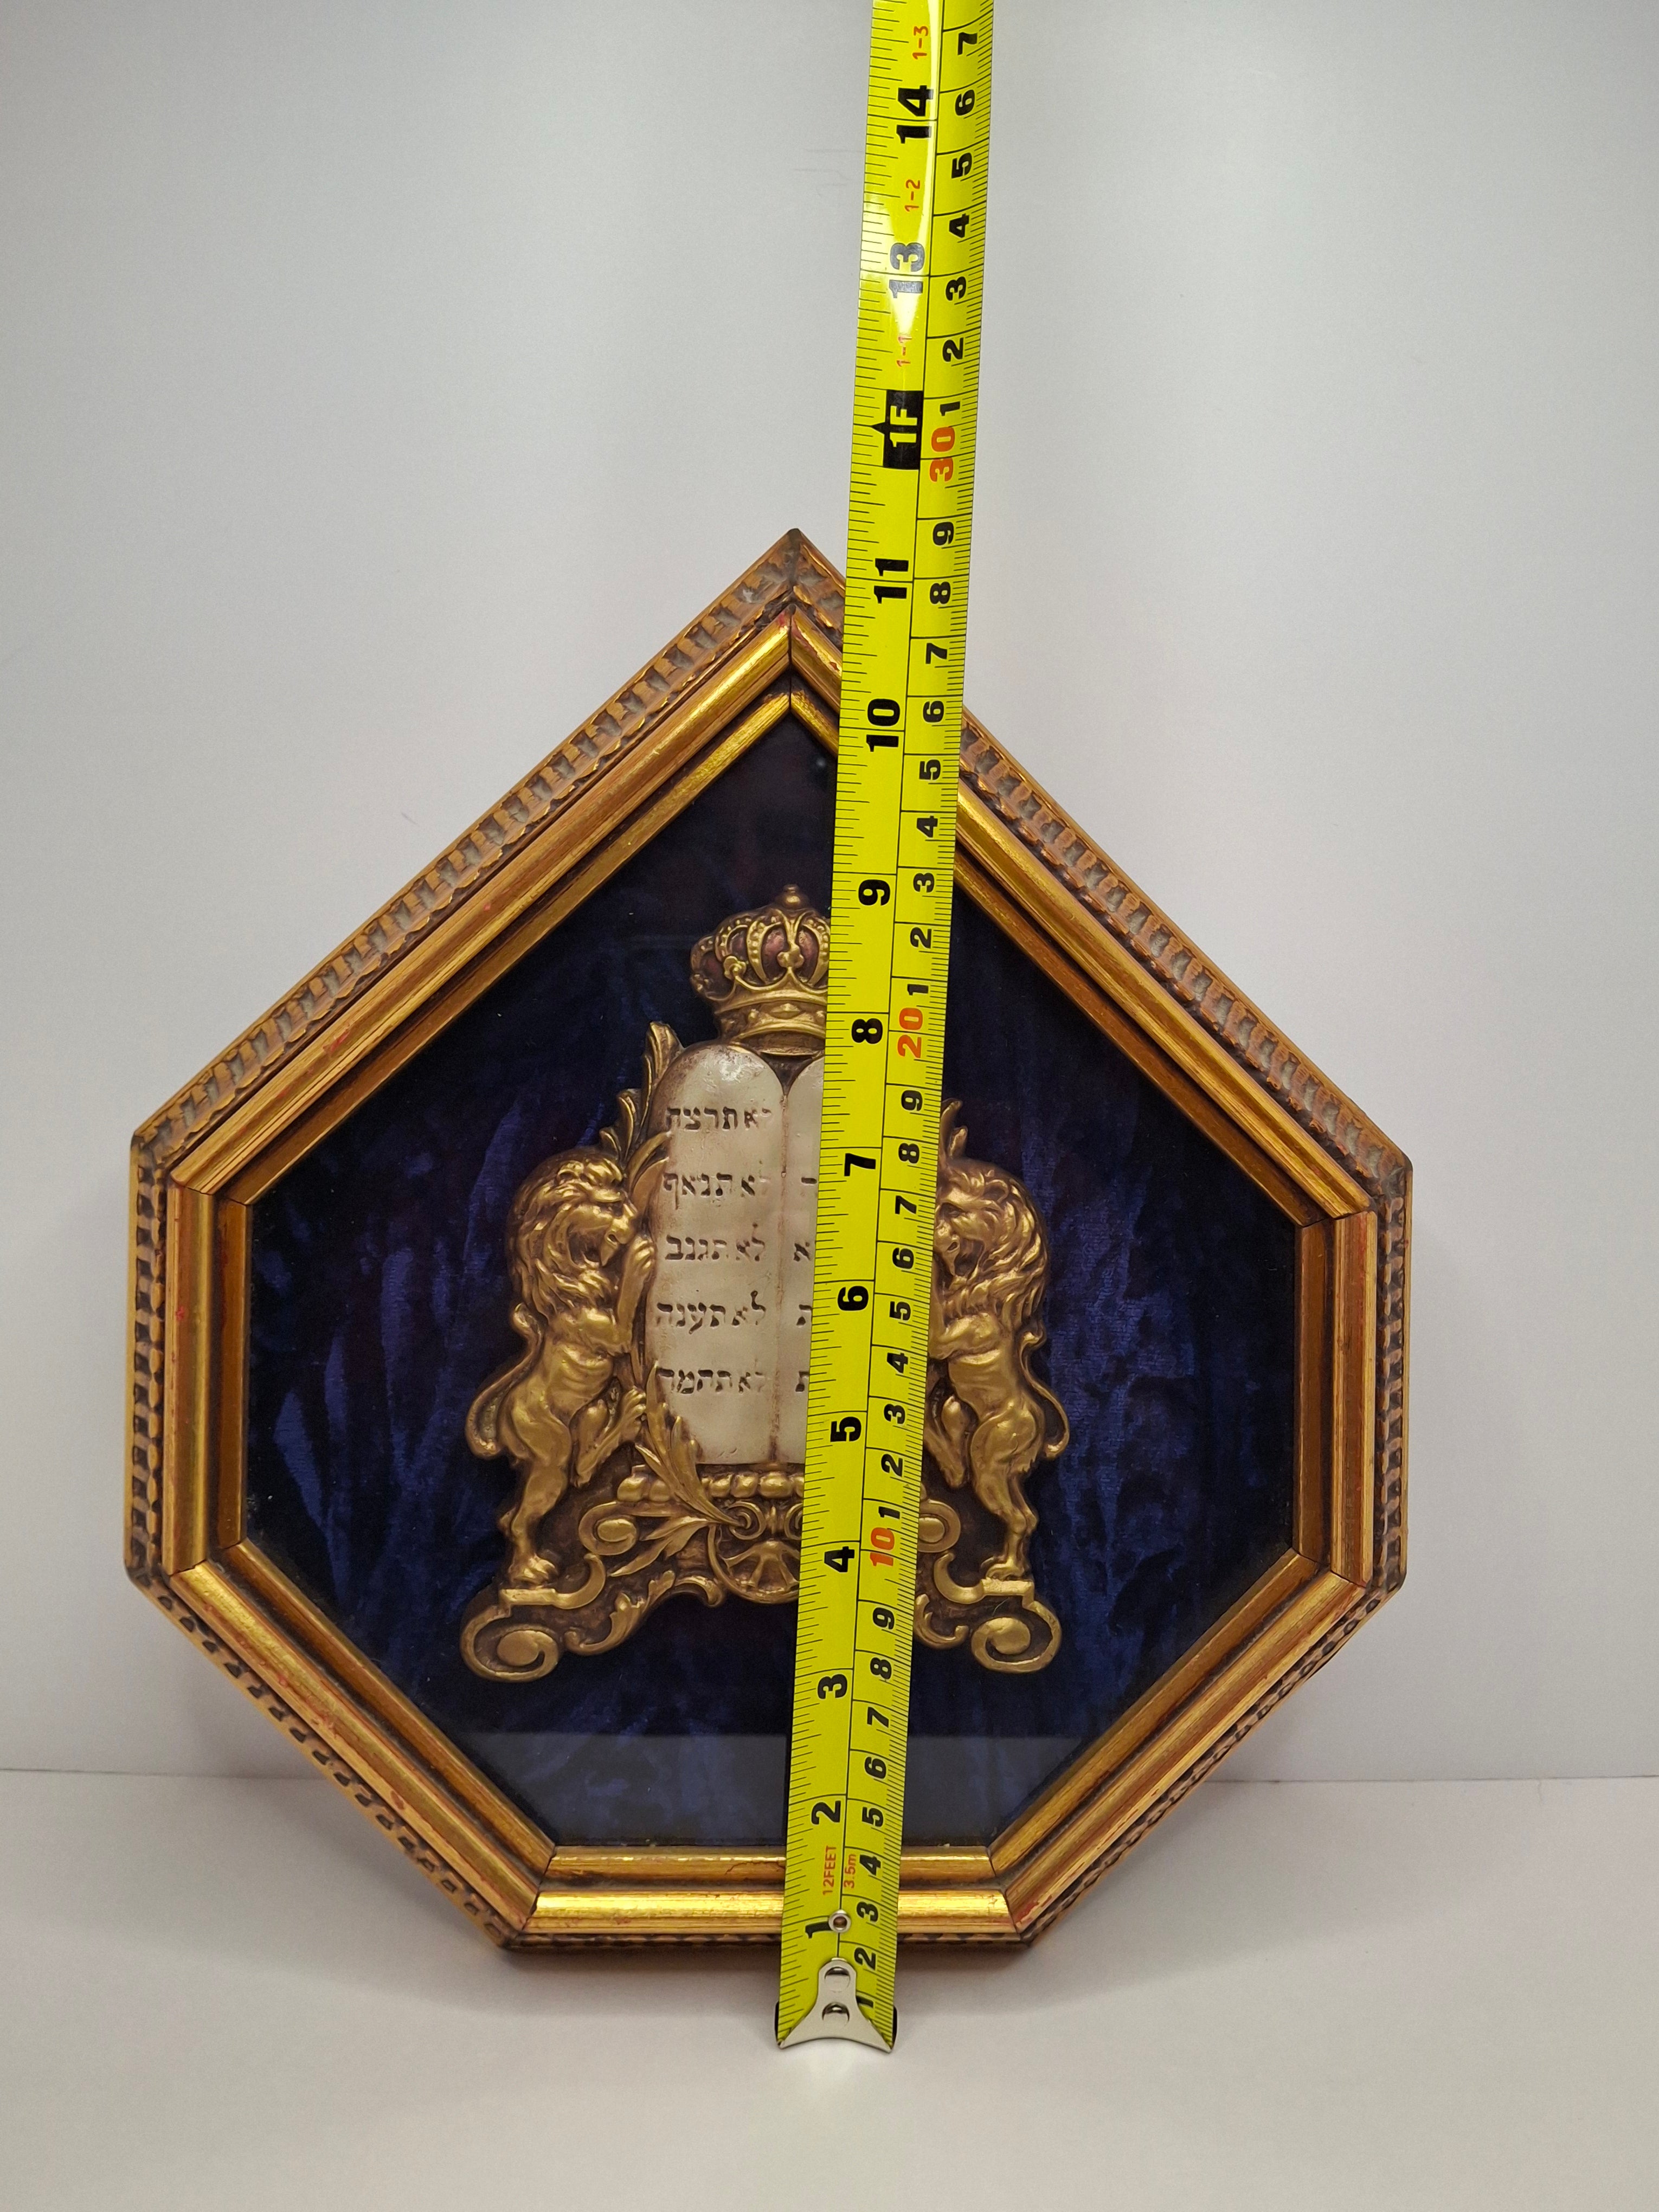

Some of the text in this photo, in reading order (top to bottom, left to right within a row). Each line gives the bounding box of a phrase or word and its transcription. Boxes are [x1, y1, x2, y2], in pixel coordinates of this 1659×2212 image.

[912, 26, 928, 60] 1-3
[957, 32, 978, 55] 7
[955, 89, 975, 116] 6
[896, 85, 933, 144] 14
[951, 152, 973, 178] 5
[904, 179, 920, 212] 1-2
[949, 214, 969, 237] 4
[889, 242, 925, 299] 13
[946, 276, 966, 301] 3
[942, 337, 964, 362] 2
[940, 401, 961, 416] 1
[890, 406, 918, 447] 1F
[930, 427, 955, 481] 30
[933, 521, 954, 545] 9
[873, 558, 909, 604] 11
[930, 581, 951, 605] 8
[925, 642, 948, 664] 7
[923, 700, 944, 723] 6
[866, 698, 901, 753] 10
[918, 759, 941, 780] 5
[917, 816, 938, 837] 4
[858, 879, 890, 906] 9
[913, 872, 934, 892] 3
[909, 927, 931, 948] 2
[906, 984, 929, 996] 1
[851, 1018, 882, 1044] 8
[897, 1007, 923, 1058] 20
[901, 1090, 923, 1111] 9
[844, 1153, 876, 1176] 7
[898, 1142, 920, 1164] 8
[895, 1195, 917, 1214] 7
[892, 1248, 914, 1269] 6
[837, 1285, 869, 1311] 6
[889, 1301, 911, 1321] 5
[886, 1353, 909, 1373] 4
[884, 1403, 906, 1425] 3
[830, 1416, 861, 1442] 5
[881, 1454, 903, 1477] 2
[878, 1505, 901, 1520] 1
[870, 1527, 895, 1567] 10
[824, 1546, 855, 1573] 4
[872, 1607, 895, 1630] 9
[870, 1656, 892, 1680] 8
[818, 1673, 848, 1699] 3
[867, 1707, 890, 1729] 7
[865, 1756, 888, 1780] 6
[811, 1801, 841, 1825] 2
[862, 1808, 884, 1828] 5
[822, 1844, 837, 1896] 12FEET
[844, 1853, 857, 1889] 3.5m
[859, 1854, 882, 1877] 4
[857, 1901, 879, 1924] 3
[805, 1921, 832, 1939] 1
[854, 1947, 876, 1970] 2
